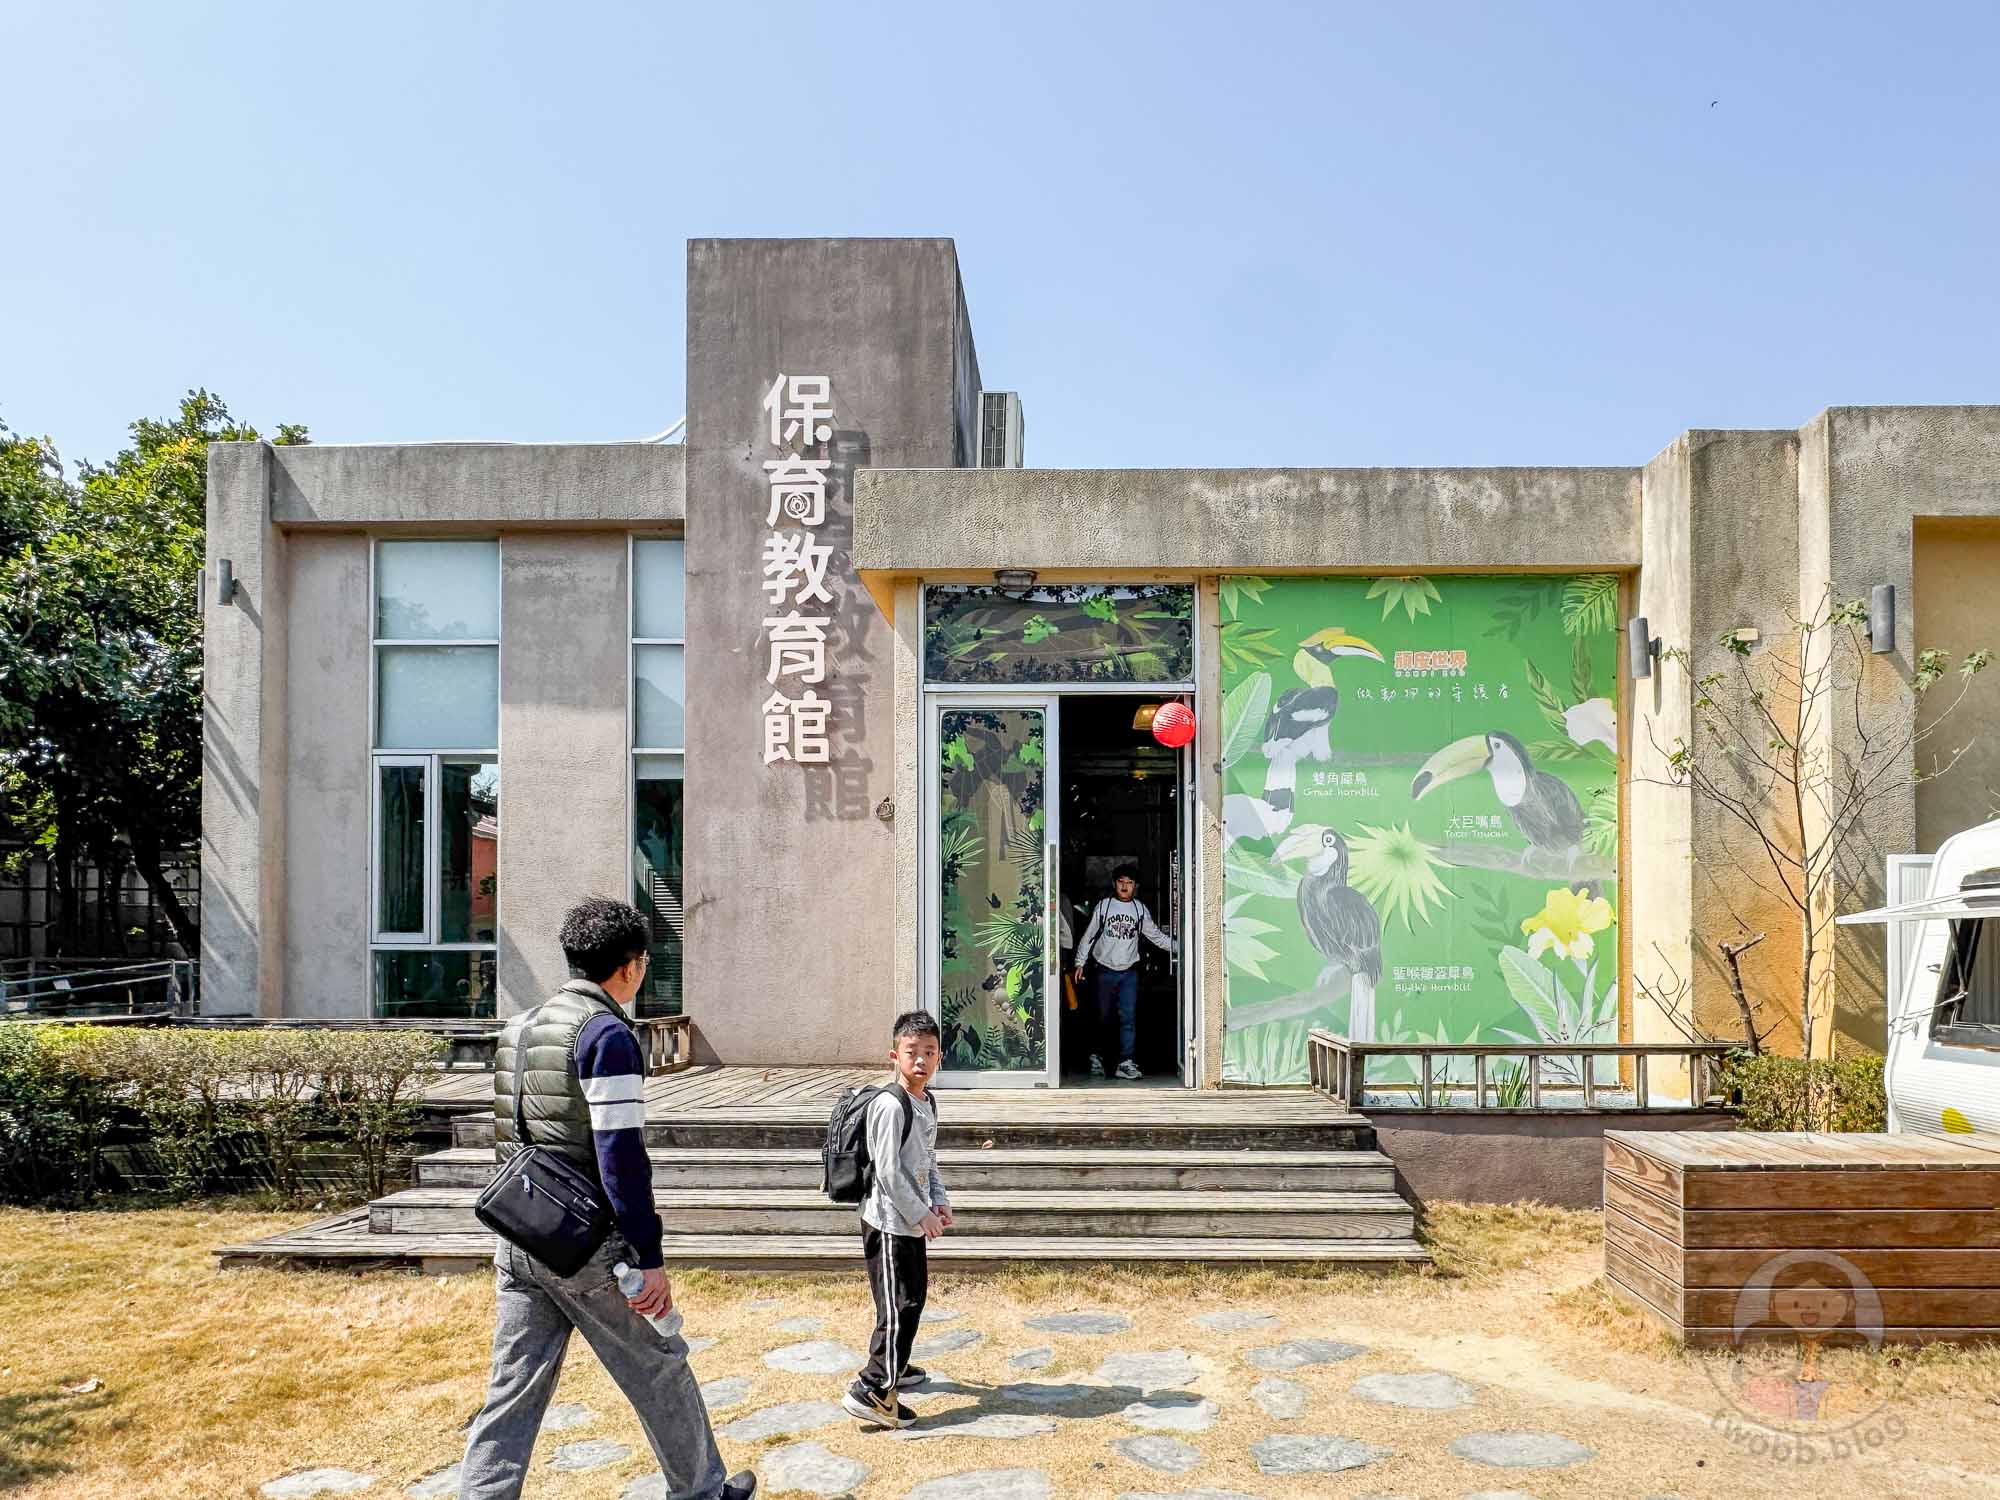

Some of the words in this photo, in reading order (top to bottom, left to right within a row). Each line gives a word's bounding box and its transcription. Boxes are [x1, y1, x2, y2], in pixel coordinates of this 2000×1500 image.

[763, 373, 834, 764] 保育教育館
[1448, 815, 1502, 829] 大巨嘴鳥
